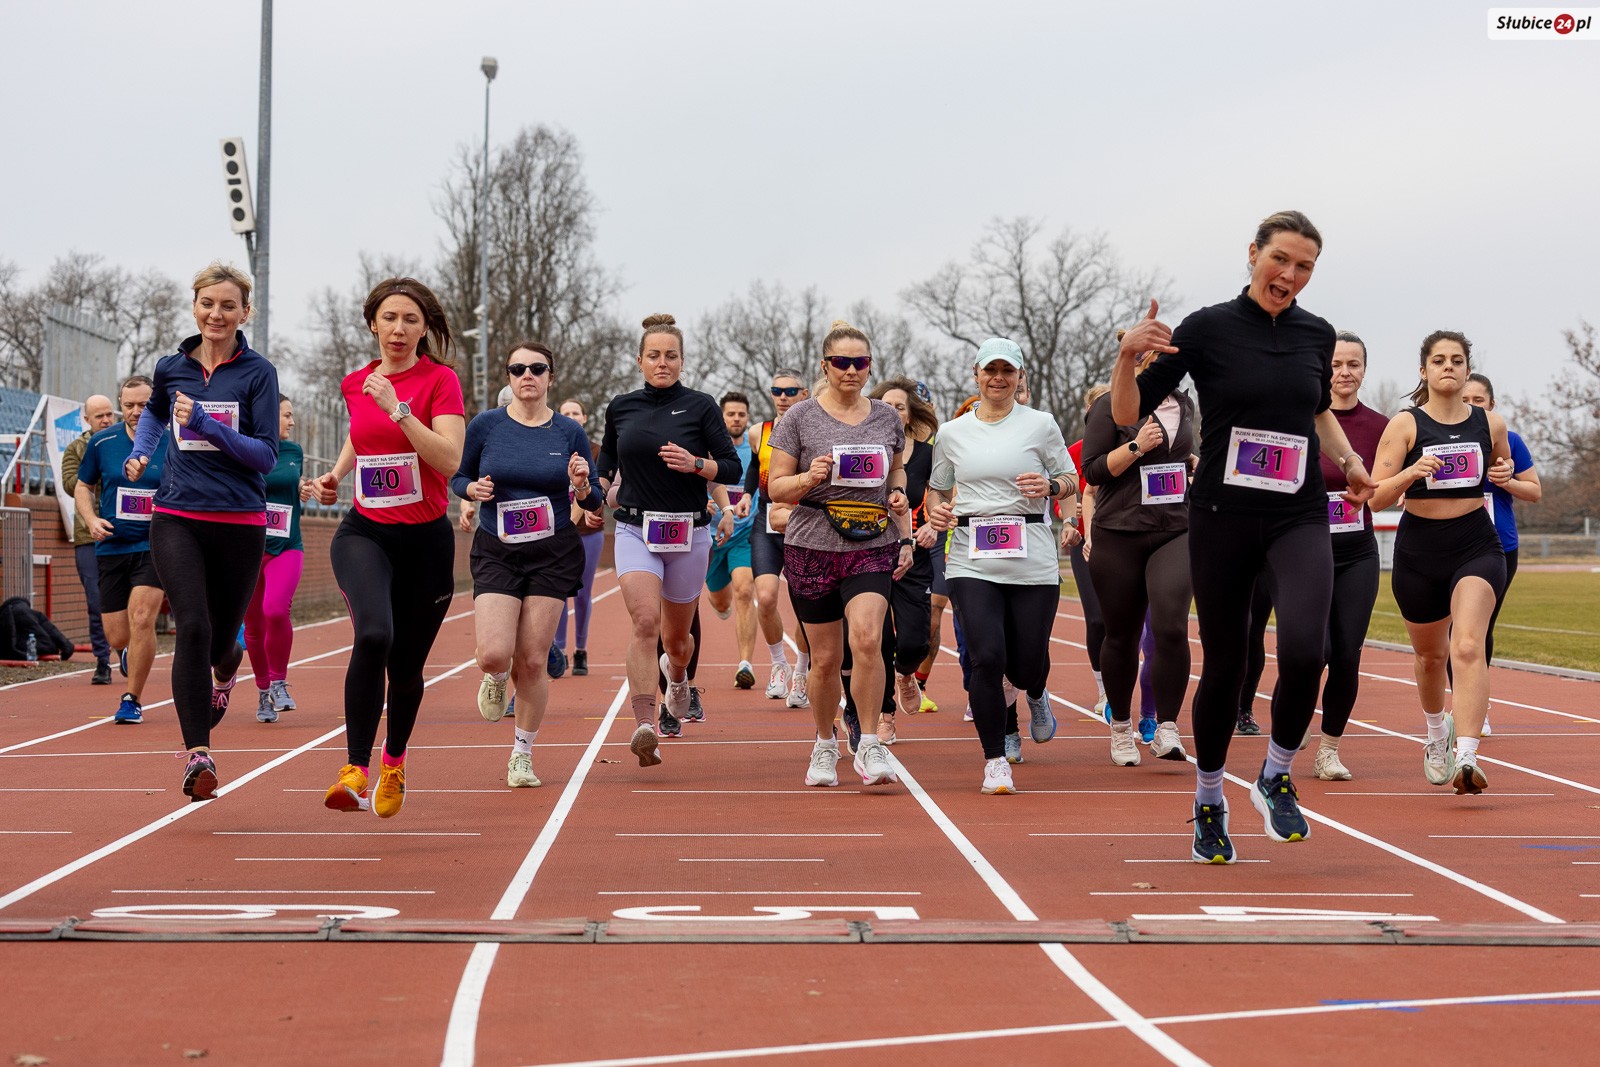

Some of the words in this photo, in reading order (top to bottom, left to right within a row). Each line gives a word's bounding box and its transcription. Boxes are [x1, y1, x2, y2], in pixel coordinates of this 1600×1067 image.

[851, 456, 874, 473] 26
[1251, 446, 1283, 472] 41
[1444, 454, 1468, 474] 59
[371, 468, 400, 490] 40
[1158, 474, 1176, 490] 11
[130, 497, 146, 510] 31
[1333, 502, 1345, 519] 4
[513, 510, 538, 529] 39
[658, 523, 679, 539] 16
[986, 527, 1010, 544] 65
[612, 905, 920, 920] 5
